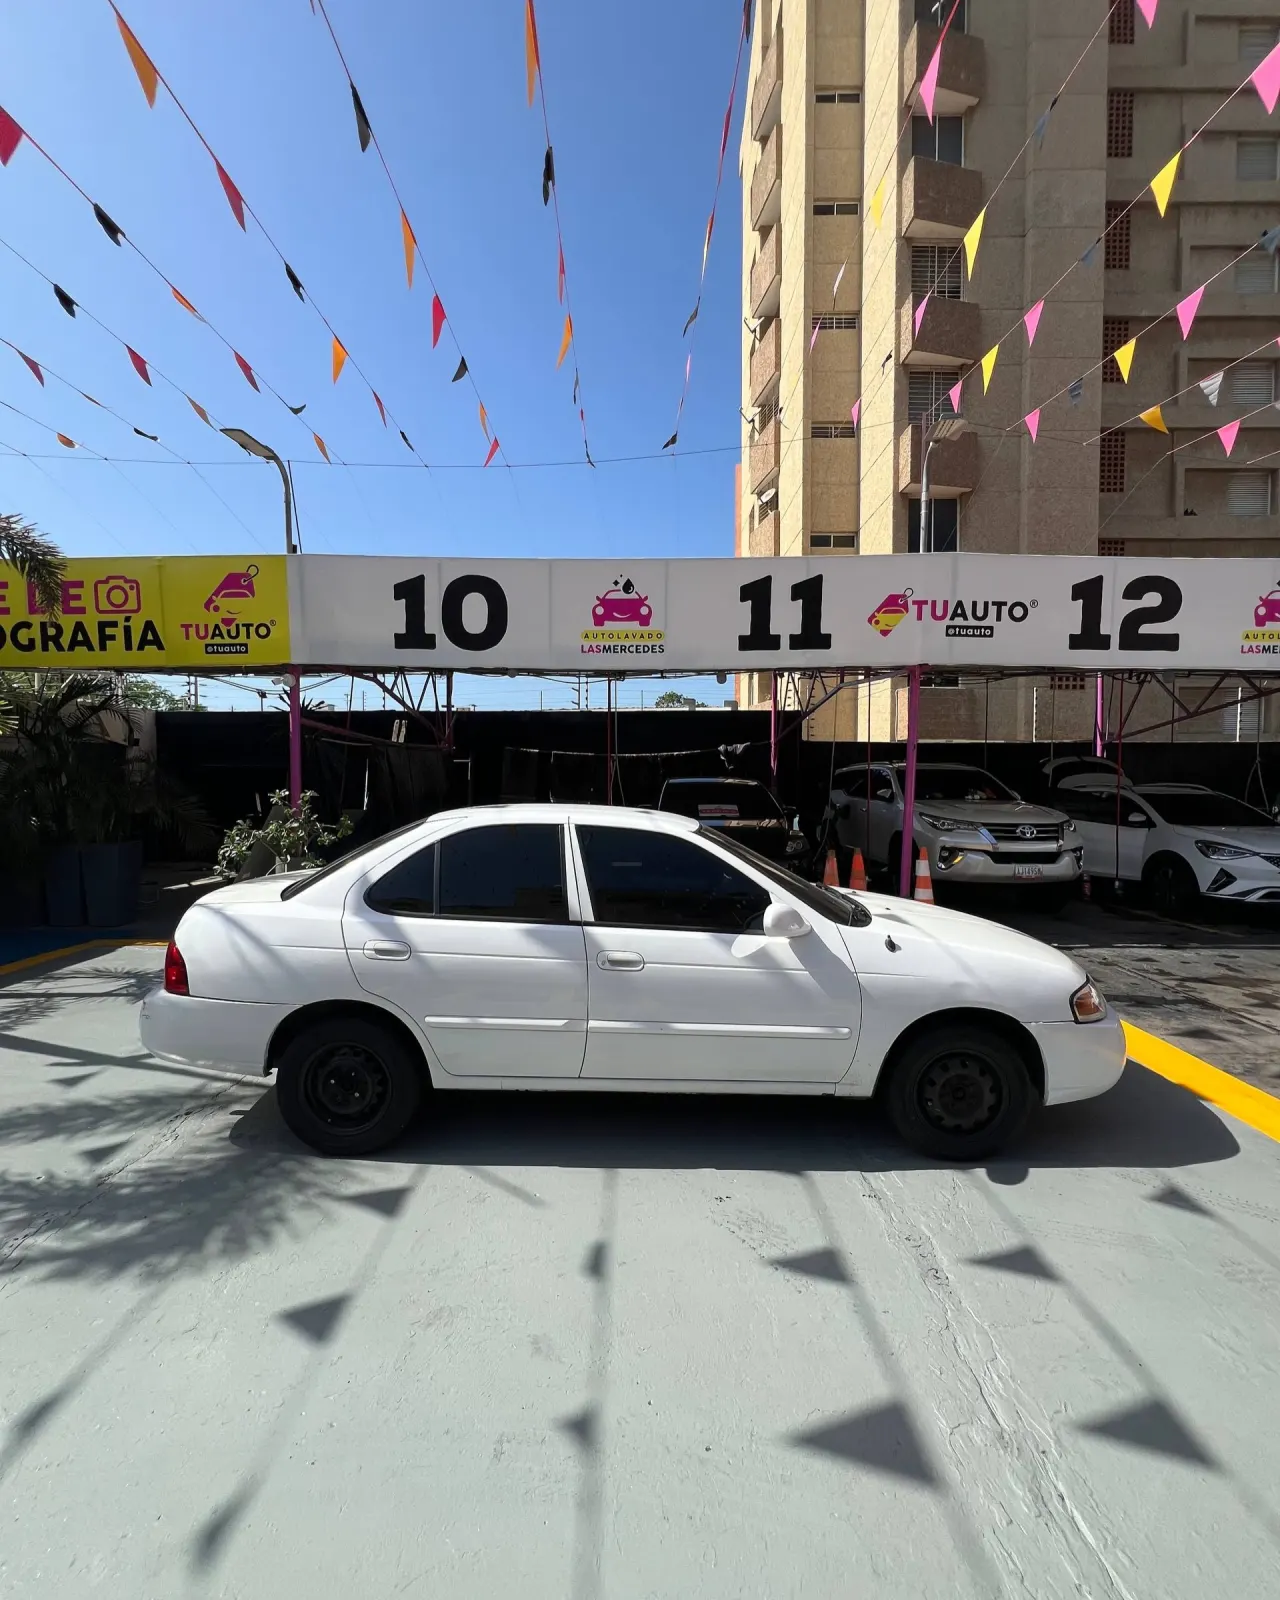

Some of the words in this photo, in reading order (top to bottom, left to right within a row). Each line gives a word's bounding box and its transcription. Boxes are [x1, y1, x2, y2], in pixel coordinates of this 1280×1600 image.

[393, 574, 508, 652] 10
[738, 573, 832, 651] 11
[1068, 574, 1183, 652] 12
[0, 616, 165, 653] GRAFÍA
[583, 632, 663, 640] AUTOLAVADO
[947, 627, 992, 637] @tuauto
[206, 645, 246, 653] @tuauto
[580, 644, 665, 654] LASMERCEDES
[1240, 644, 1280, 654] LASME
